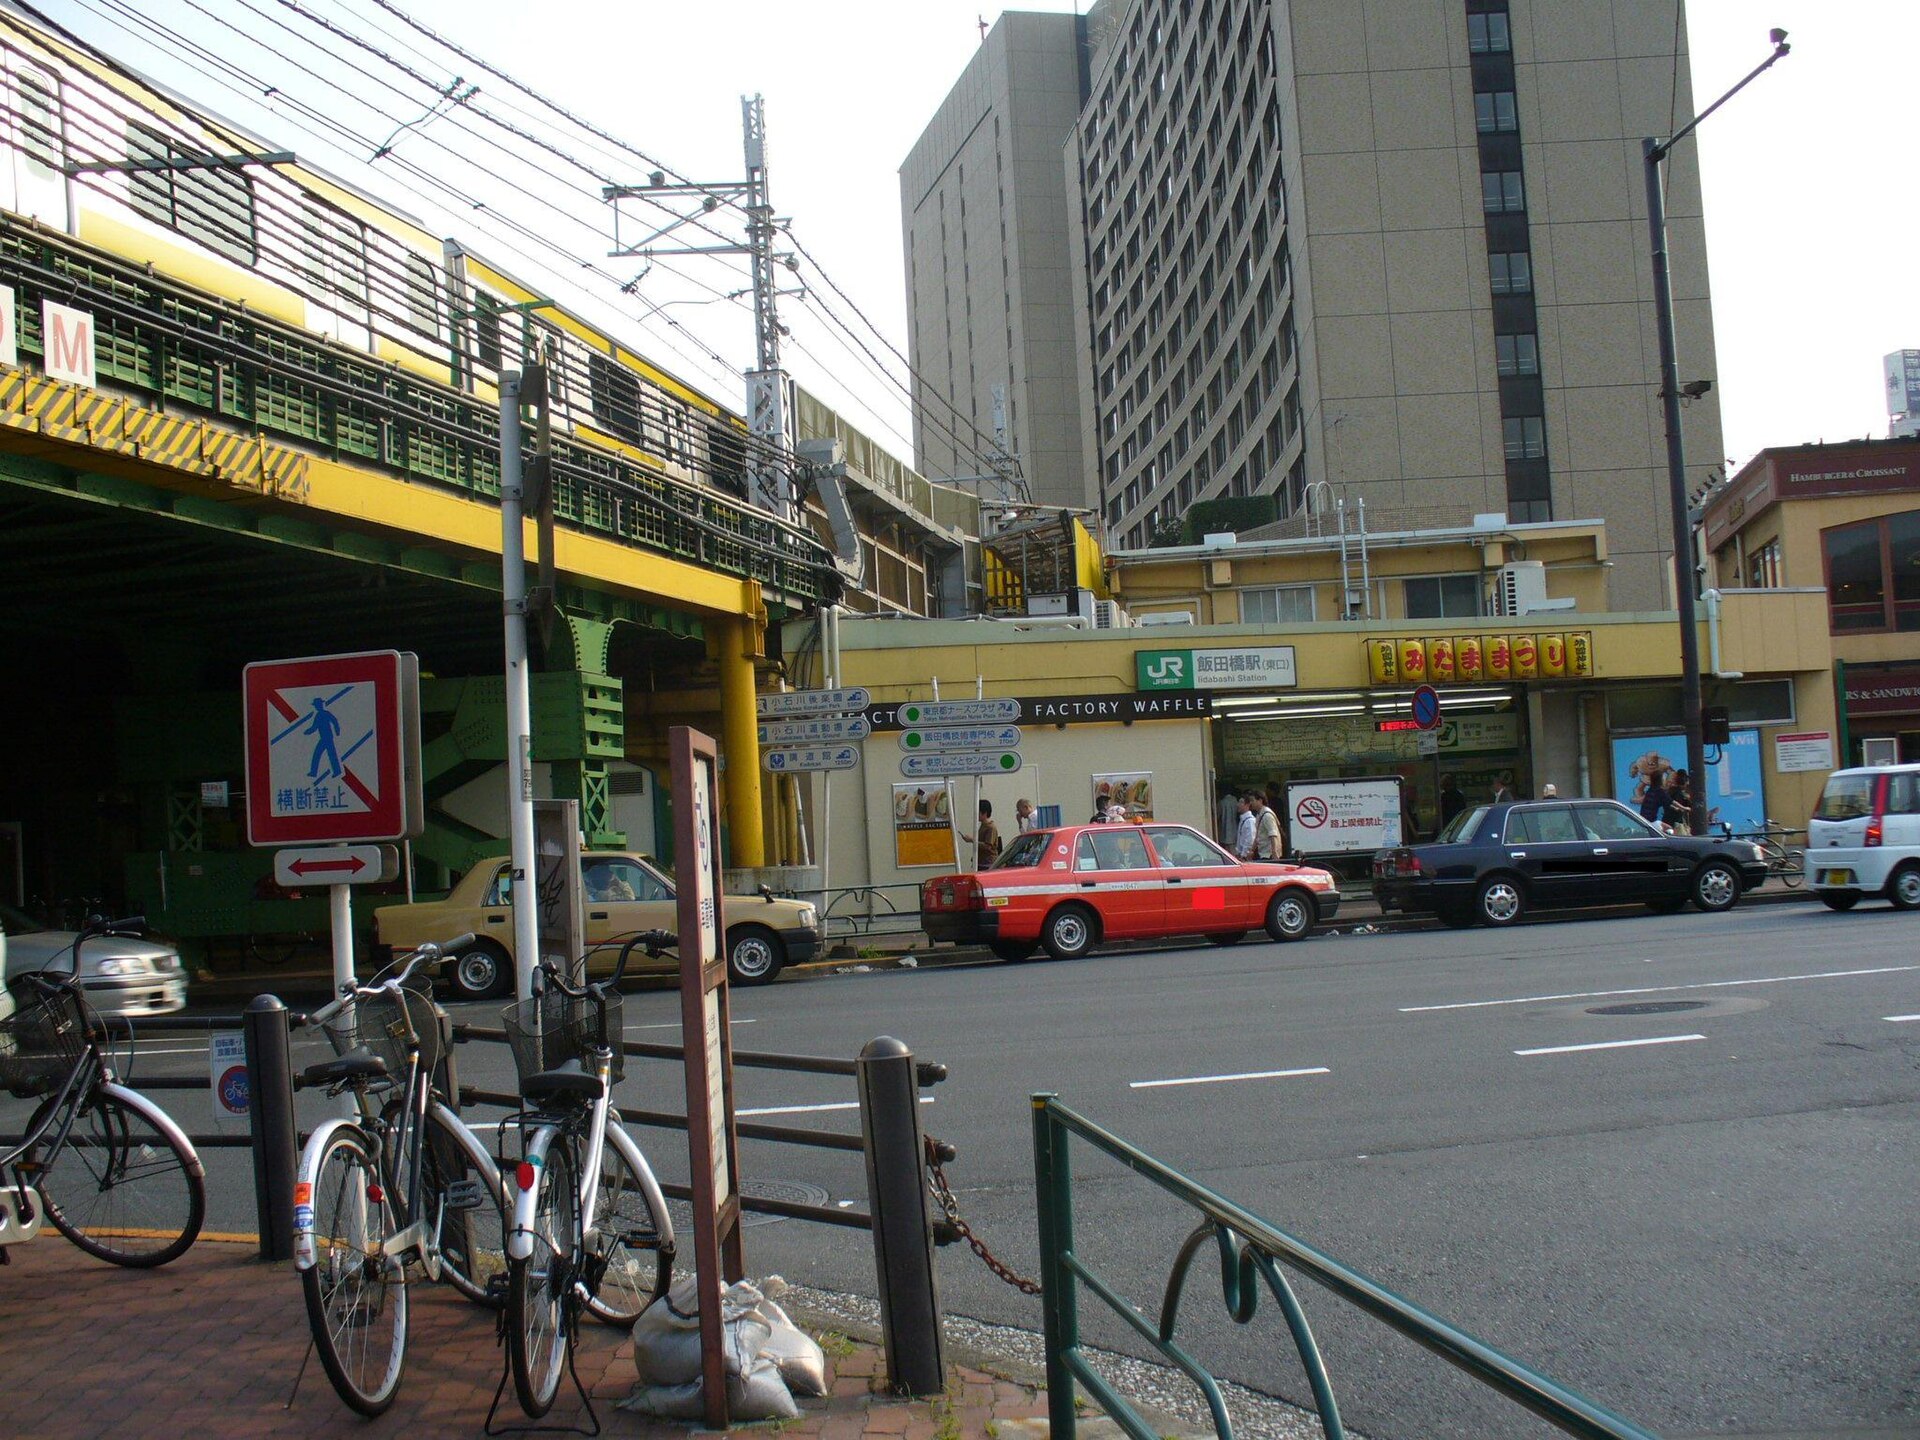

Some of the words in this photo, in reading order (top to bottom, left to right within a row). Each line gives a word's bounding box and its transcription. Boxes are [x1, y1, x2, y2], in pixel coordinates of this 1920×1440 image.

[53, 314, 88, 376] M
[1147, 656, 1183, 678] JR
[1198, 675, 1235, 683] Iidabashi
[1238, 674, 1267, 682] Station
[1035, 701, 1119, 716] FACTORY
[1134, 698, 1205, 712] WAFFLE
[1732, 734, 1754, 745] Wii
[277, 785, 348, 810] 横断禁止
[1330, 816, 1383, 828] 路上喫煙禁止
